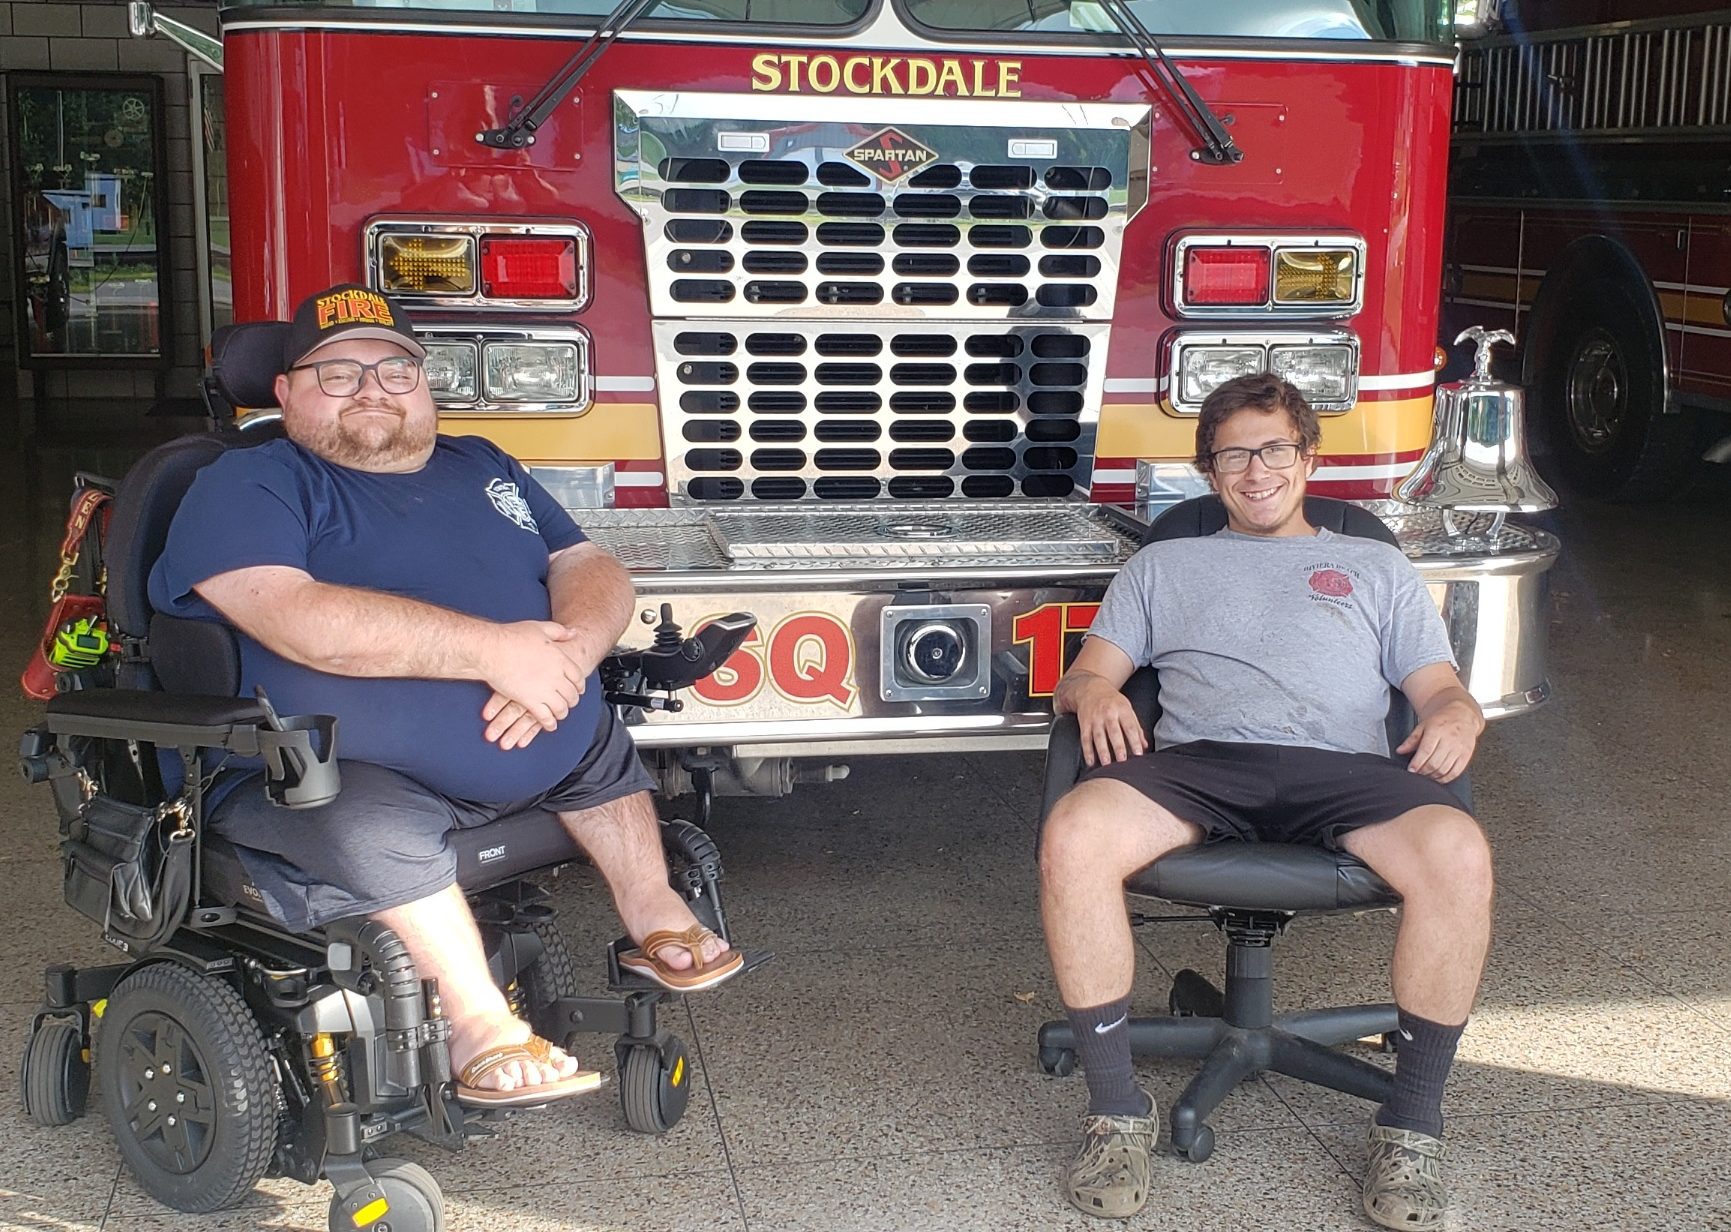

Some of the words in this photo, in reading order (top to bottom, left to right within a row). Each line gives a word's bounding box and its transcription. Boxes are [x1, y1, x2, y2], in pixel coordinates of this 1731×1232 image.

[751, 53, 1022, 98] STOCKDALE
[853, 149, 927, 162] SPARTAN
[317, 289, 387, 309] STOCKDALE
[317, 299, 393, 326] FIRE
[687, 610, 860, 713] SQ
[479, 845, 506, 861] FRONT
